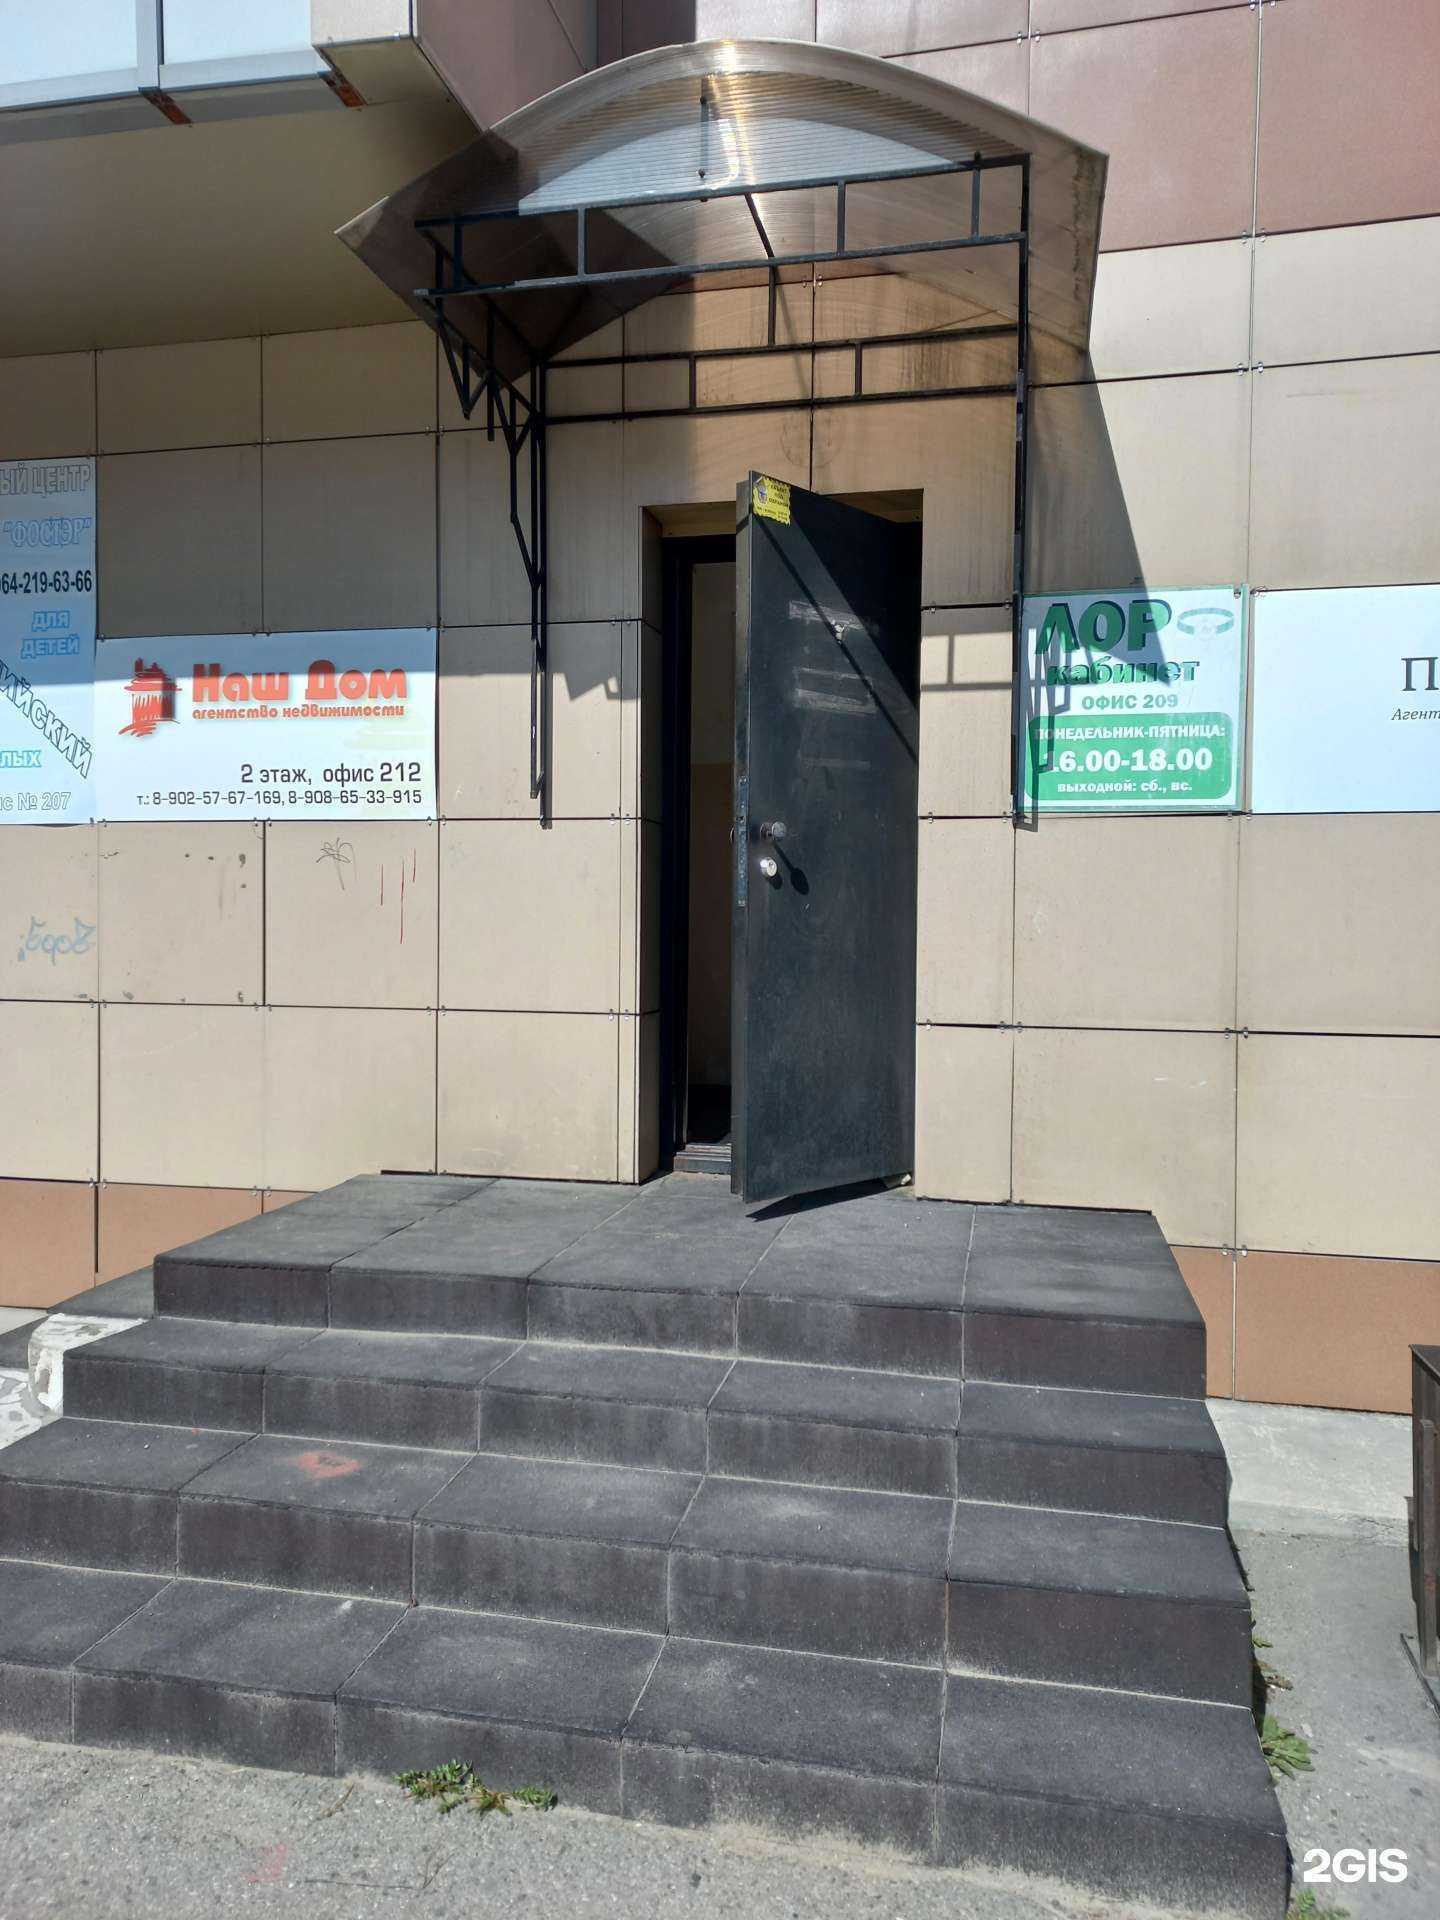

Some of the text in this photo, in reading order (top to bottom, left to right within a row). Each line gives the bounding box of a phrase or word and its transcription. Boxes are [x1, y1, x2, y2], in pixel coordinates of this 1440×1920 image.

[31, 464, 91, 498] ЦЕНТР
[0, 569, 92, 595] 64-219-63-66
[32, 610, 70, 632] ДЛЯ
[1035, 599, 1172, 655] ЛОР
[21, 635, 80, 659] ДЕТЕЙ
[192, 659, 408, 703] Наш Дом
[1046, 656, 1200, 686] кабинет
[192, 703, 404, 720] агентство недвижимости
[1081, 694, 1179, 711] ОФИС 209
[0, 659, 92, 779] ИЙСКИЙ
[240, 762, 422, 787] 2 этаж, офис 212
[1057, 779, 1137, 794] выходной:
[41, 792, 71, 811] 207
